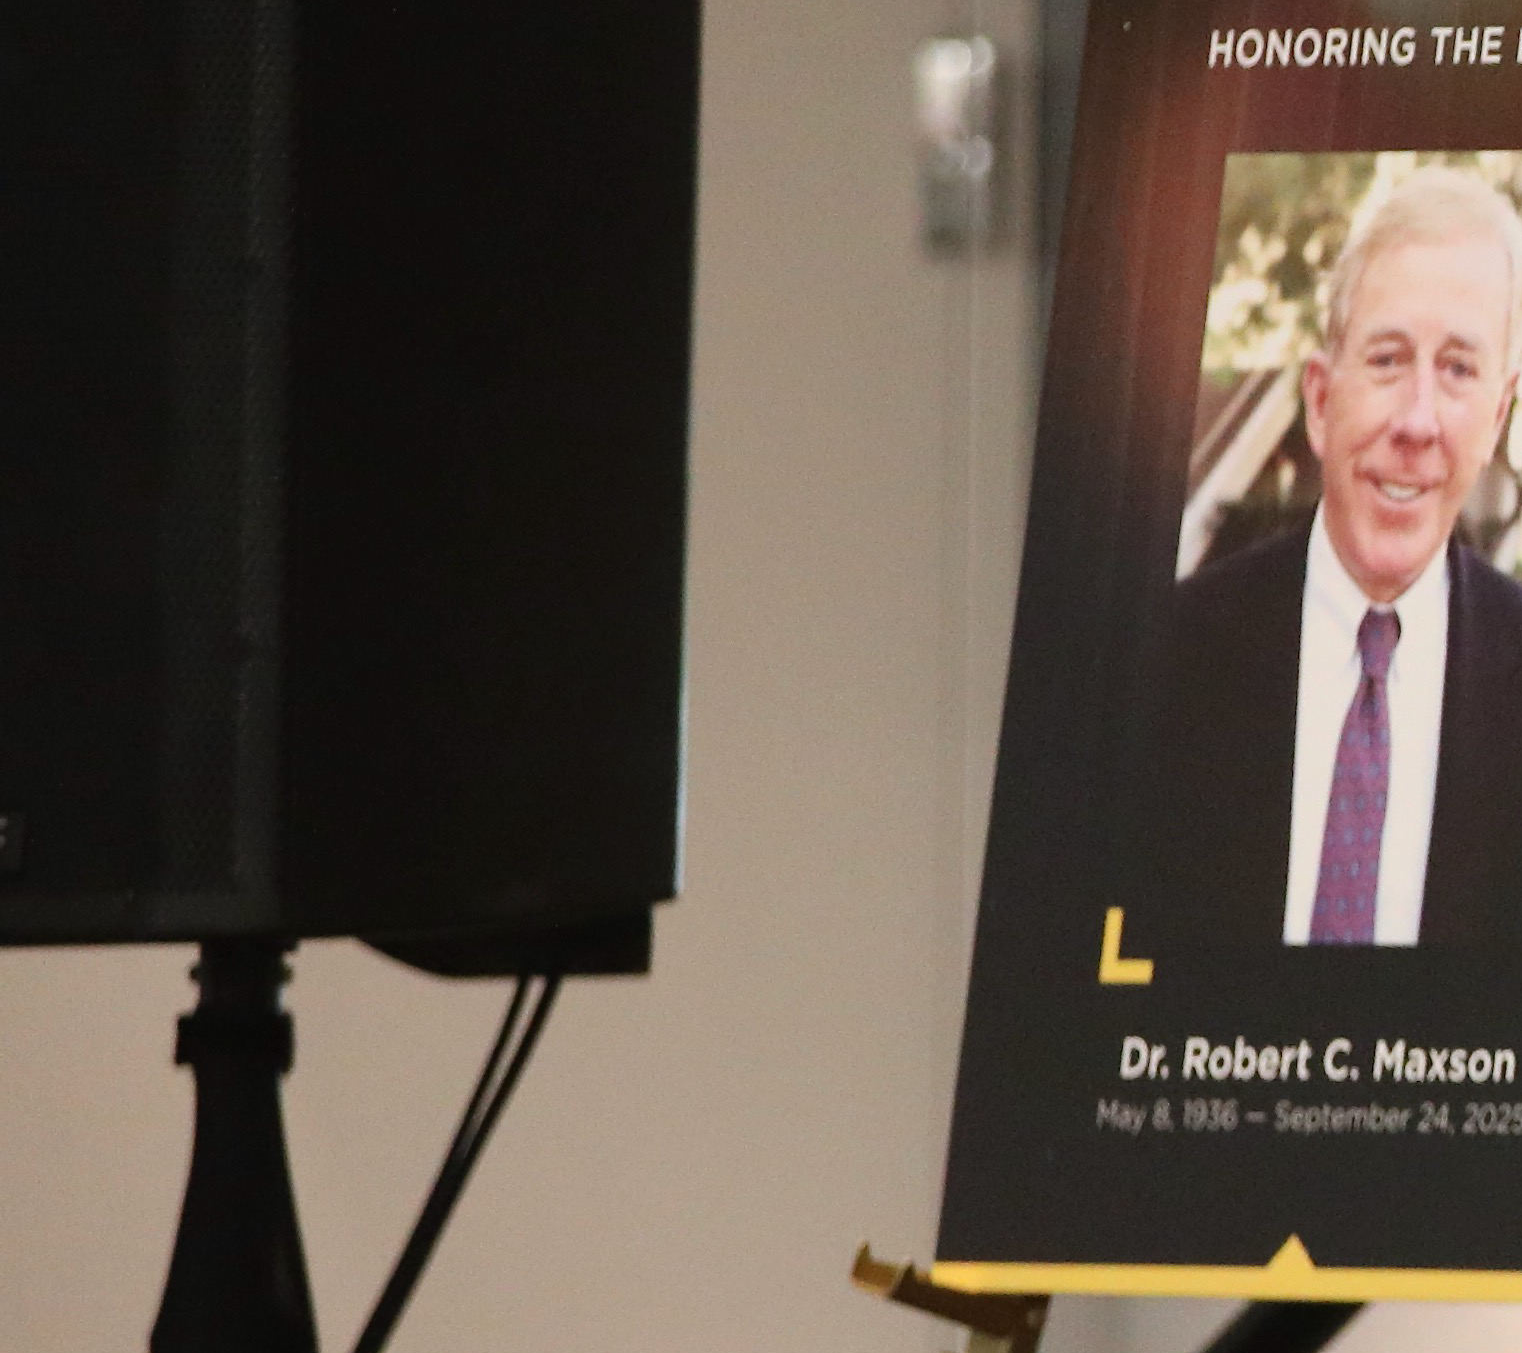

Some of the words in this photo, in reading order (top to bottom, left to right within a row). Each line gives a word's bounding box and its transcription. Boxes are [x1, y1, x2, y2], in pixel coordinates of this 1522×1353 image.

[1207, 26, 1416, 69] HONORING
[1431, 25, 1505, 67] THE
[1119, 1035, 1169, 1081] Dr.
[1182, 1035, 1312, 1081] Robert
[1323, 1038, 1359, 1082] C.
[1372, 1038, 1517, 1084] Maxson
[1097, 1098, 1148, 1136] May
[1151, 1098, 1174, 1133] 8,
[1183, 1098, 1239, 1132] 1936
[1274, 1098, 1411, 1137] September
[1416, 1100, 1455, 1136] 24,
